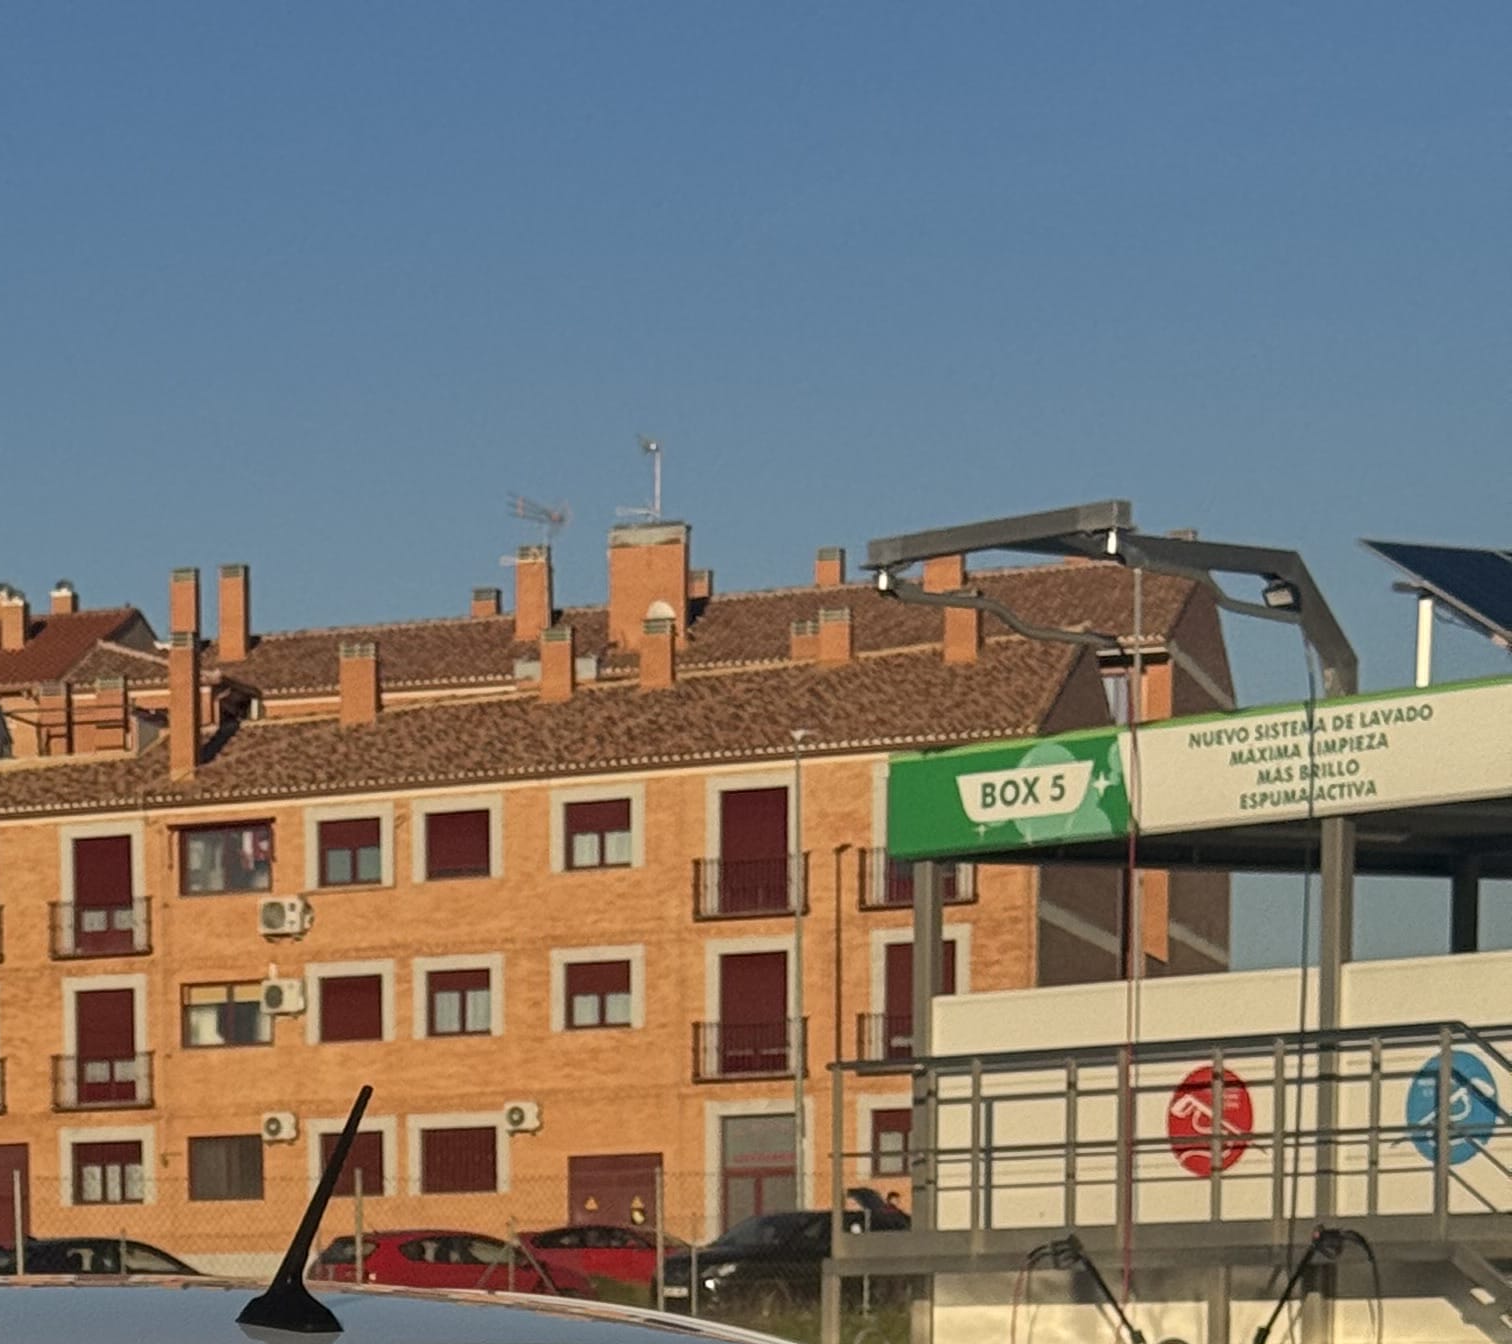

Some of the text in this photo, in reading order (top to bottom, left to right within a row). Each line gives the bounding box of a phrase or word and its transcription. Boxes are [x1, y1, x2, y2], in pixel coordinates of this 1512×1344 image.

[1188, 703, 1434, 748] NUEVO SISTEMA DE LAVADO
[1299, 759, 1360, 780] BRILLO
[981, 774, 1065, 809] BOX 5
[1239, 780, 1377, 810] ESPUMA ACTIVA
